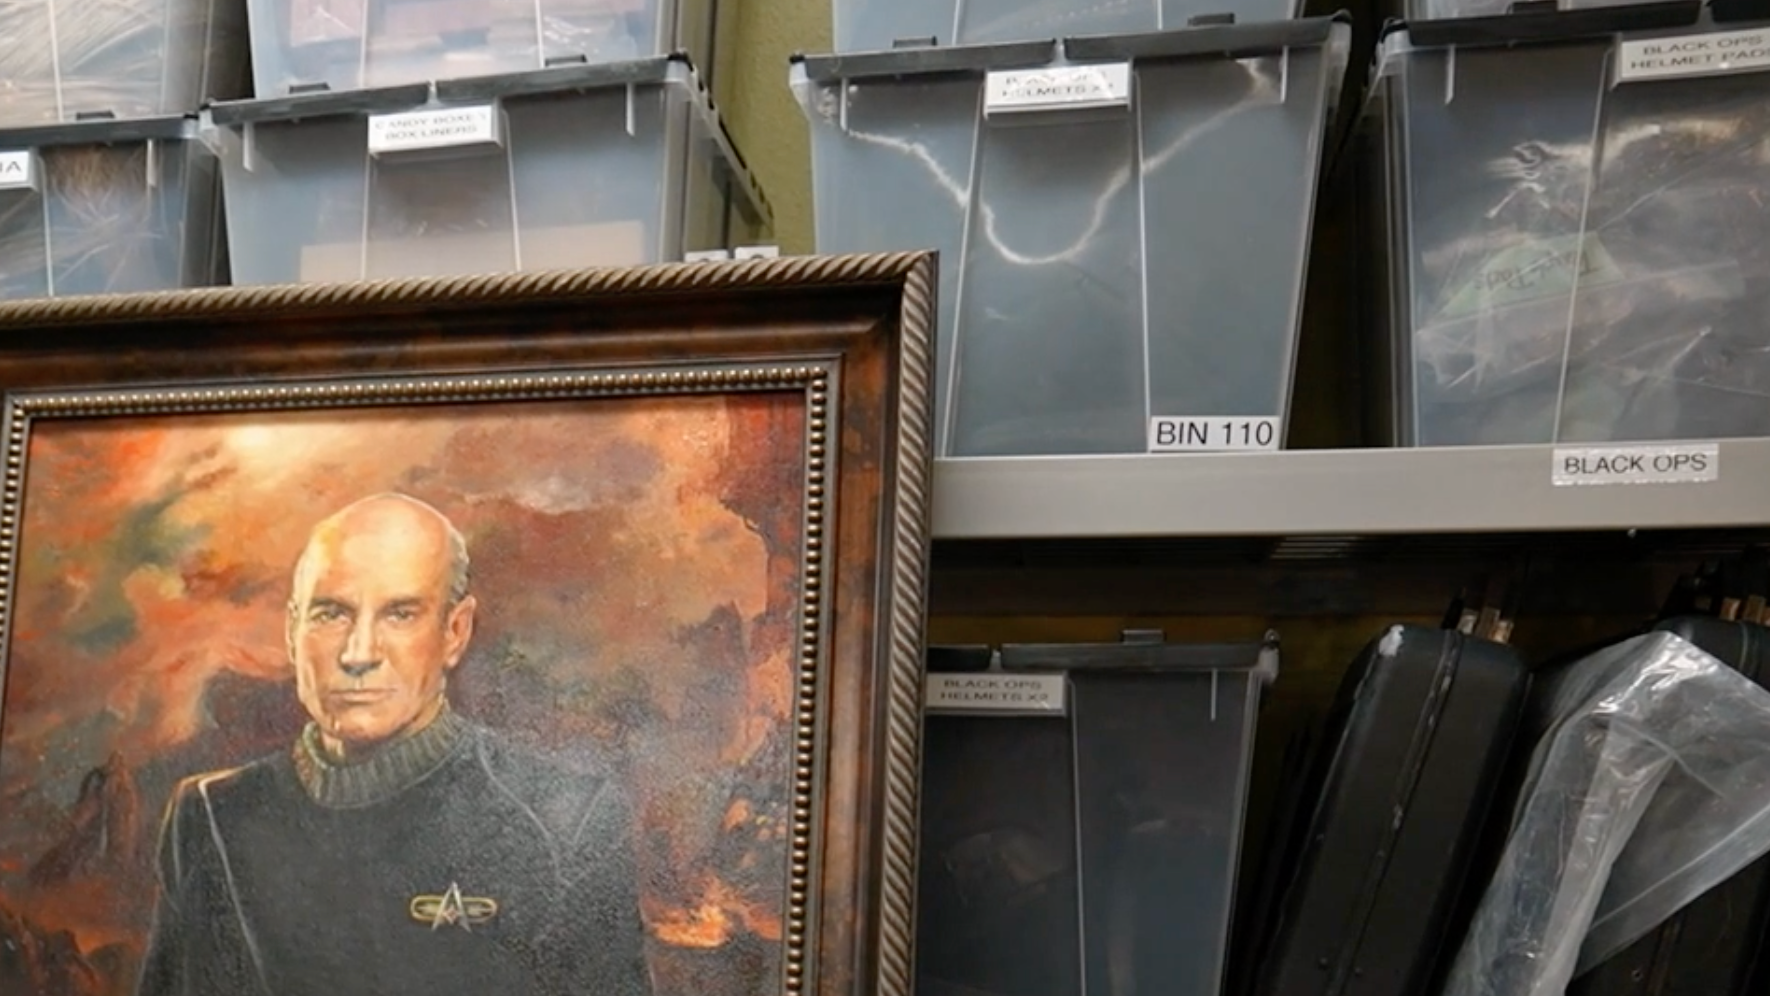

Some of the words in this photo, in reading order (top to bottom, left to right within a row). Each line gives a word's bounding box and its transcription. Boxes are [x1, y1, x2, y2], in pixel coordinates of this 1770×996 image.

[1642, 41, 1711, 56] BLACK
[1716, 34, 1763, 49] OPS
[1630, 54, 1714, 69] HELMET
[1722, 46, 1770, 62] PAD
[1156, 421, 1208, 445] BIN
[1221, 420, 1274, 446] 110
[1564, 454, 1645, 475] BLACK
[1653, 452, 1708, 473] OPS
[940, 691, 1023, 701] HELMETS
[943, 679, 999, 690] BLACK
[1003, 680, 1043, 691] OPS
